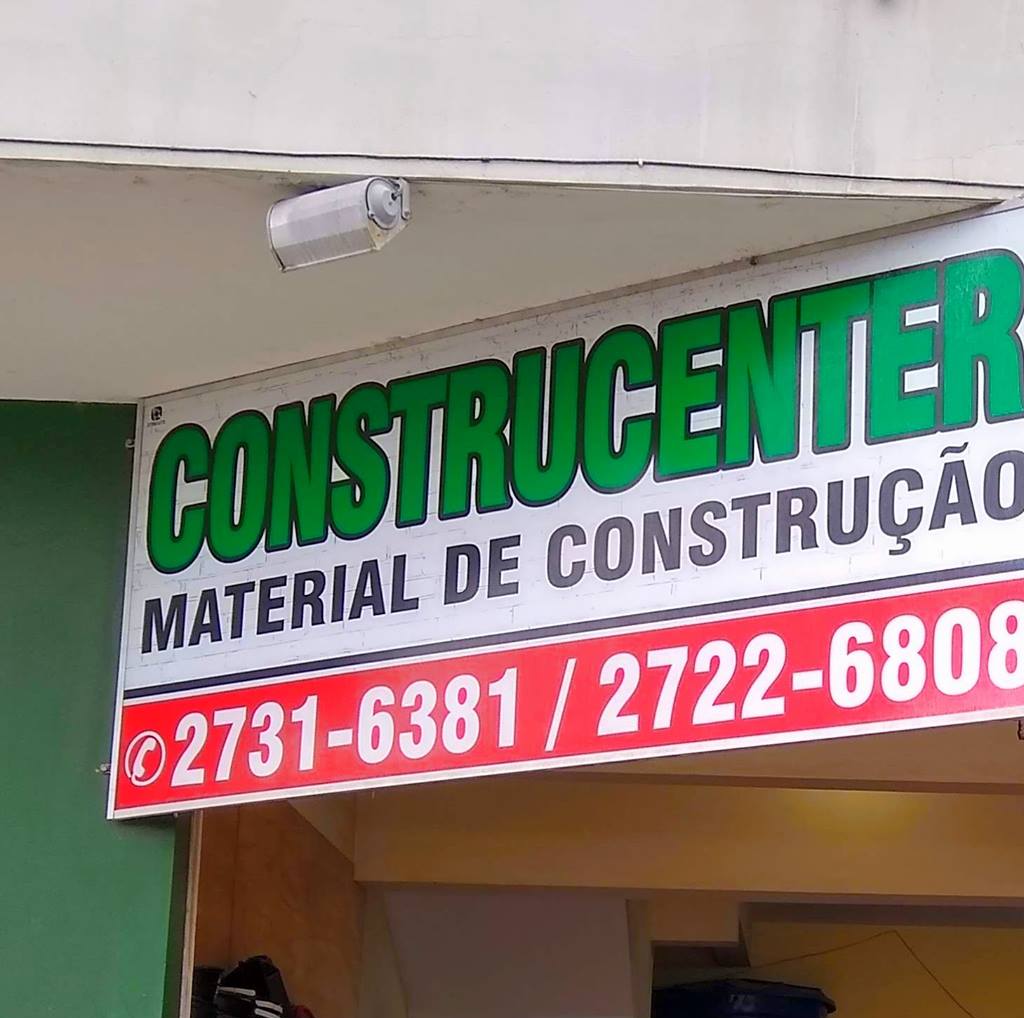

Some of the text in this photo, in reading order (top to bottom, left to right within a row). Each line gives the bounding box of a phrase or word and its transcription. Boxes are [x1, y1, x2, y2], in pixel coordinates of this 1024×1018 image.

[141, 555, 420, 654] MATERIAL
[444, 535, 522, 606] DE
[170, 667, 519, 788] 2731-6381
[545, 658, 576, 752] /
